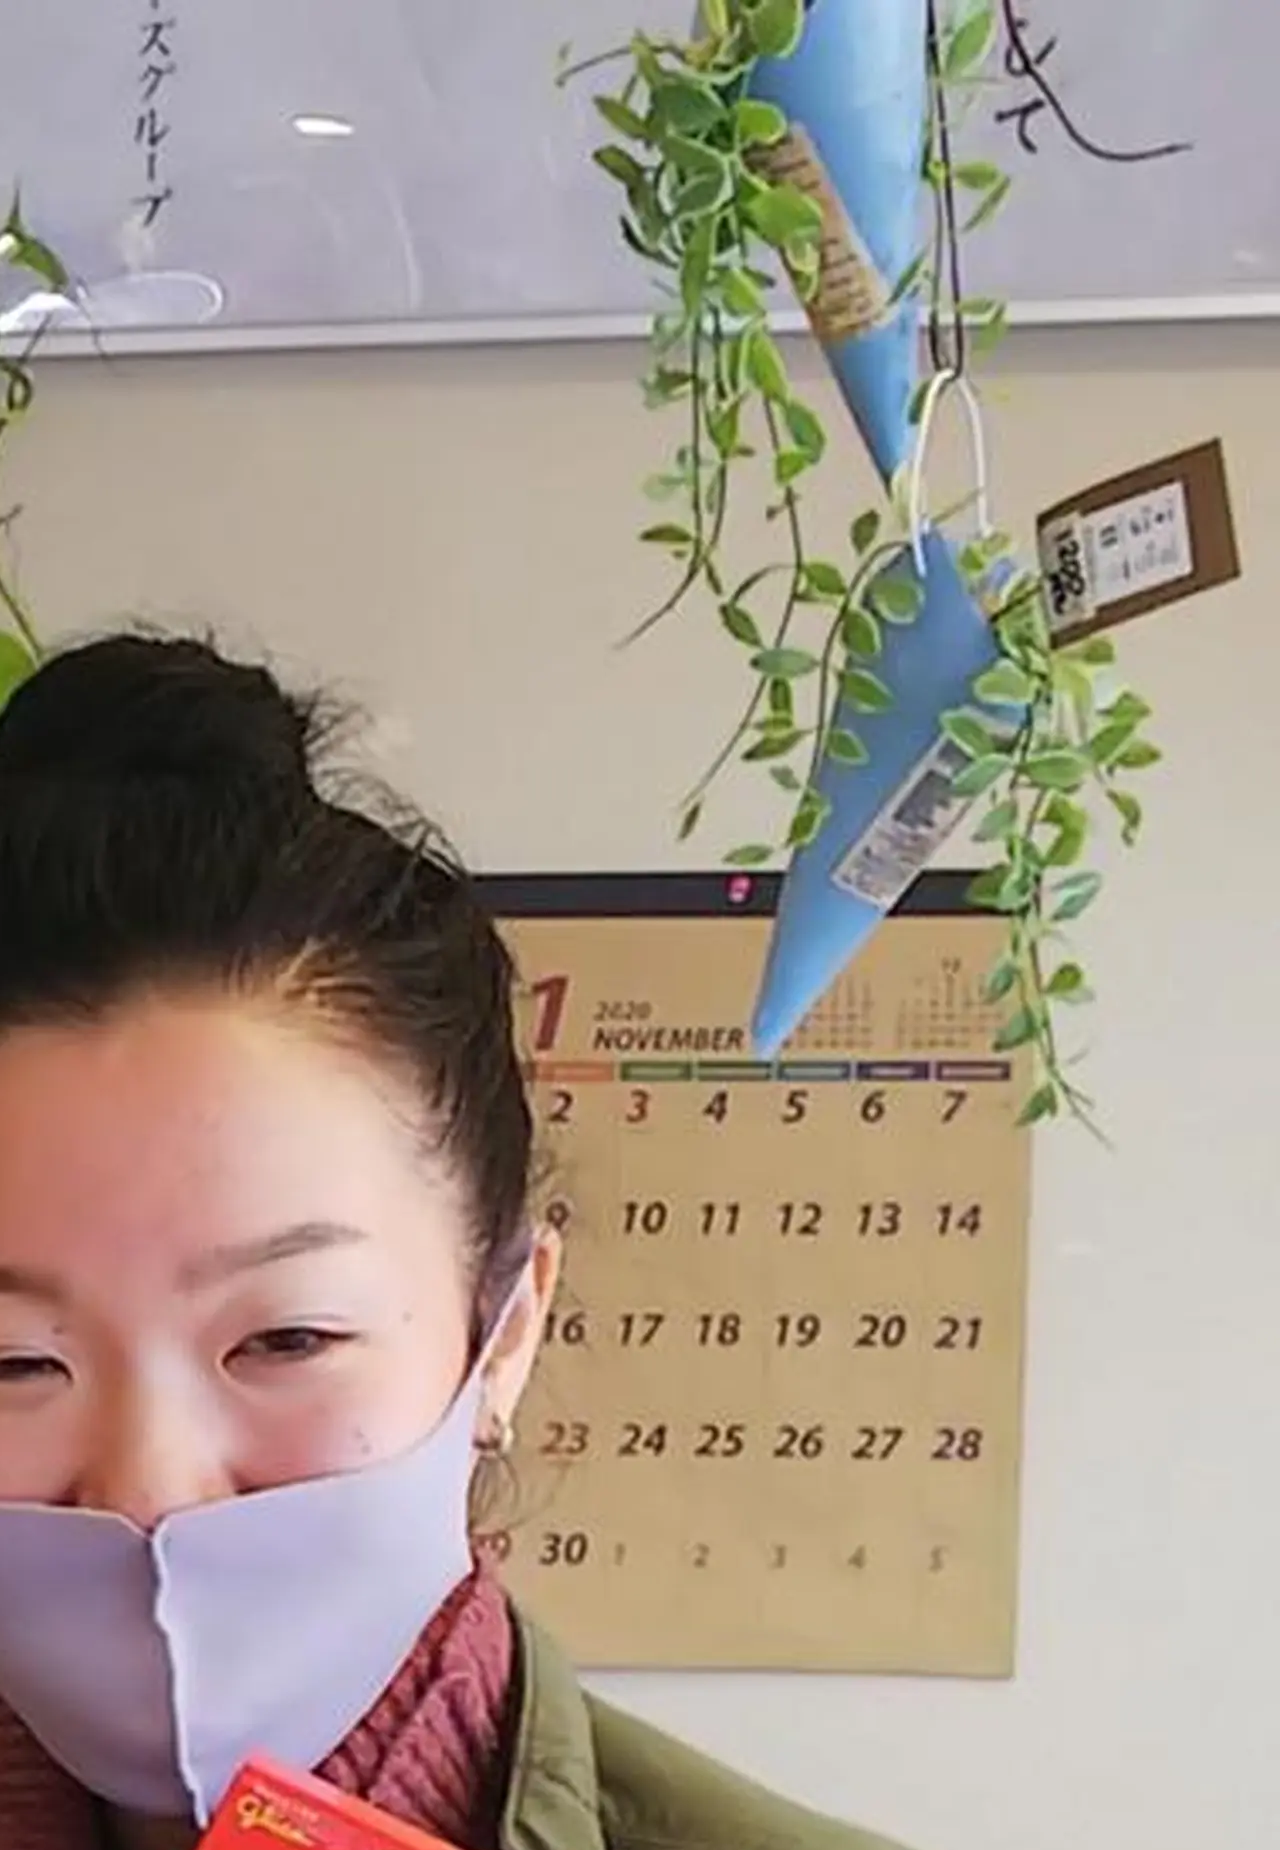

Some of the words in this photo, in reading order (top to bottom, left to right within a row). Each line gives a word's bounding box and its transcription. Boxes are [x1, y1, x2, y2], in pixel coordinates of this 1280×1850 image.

[593, 1000, 652, 1023] 2020
[592, 1027, 745, 1052] NOVEMBER
[549, 1090, 574, 1122] 2
[626, 1090, 651, 1123] 3
[704, 1091, 728, 1123] 4
[781, 1091, 808, 1123] 5
[860, 1091, 885, 1123] 6
[942, 1092, 967, 1124] 7
[623, 1201, 668, 1235] 10
[700, 1202, 741, 1236] 11
[779, 1202, 822, 1236] 12
[858, 1203, 902, 1237] 13
[938, 1203, 982, 1237] 14
[544, 1311, 586, 1345] 16
[620, 1313, 665, 1346] 17
[699, 1314, 741, 1346] 18
[776, 1315, 820, 1347] 19
[855, 1315, 907, 1348] 20
[934, 1316, 983, 1349] 21
[541, 1422, 590, 1456] 23
[617, 1424, 667, 1457] 24
[694, 1424, 745, 1458] 25
[773, 1425, 825, 1460] 26
[851, 1427, 904, 1460] 27
[931, 1428, 983, 1462] 28
[540, 1533, 588, 1566] 30
[614, 1543, 627, 1565] 1
[693, 1544, 710, 1568] 2
[770, 1546, 786, 1569] 3
[848, 1546, 866, 1569] 4
[928, 1547, 944, 1571] 5
